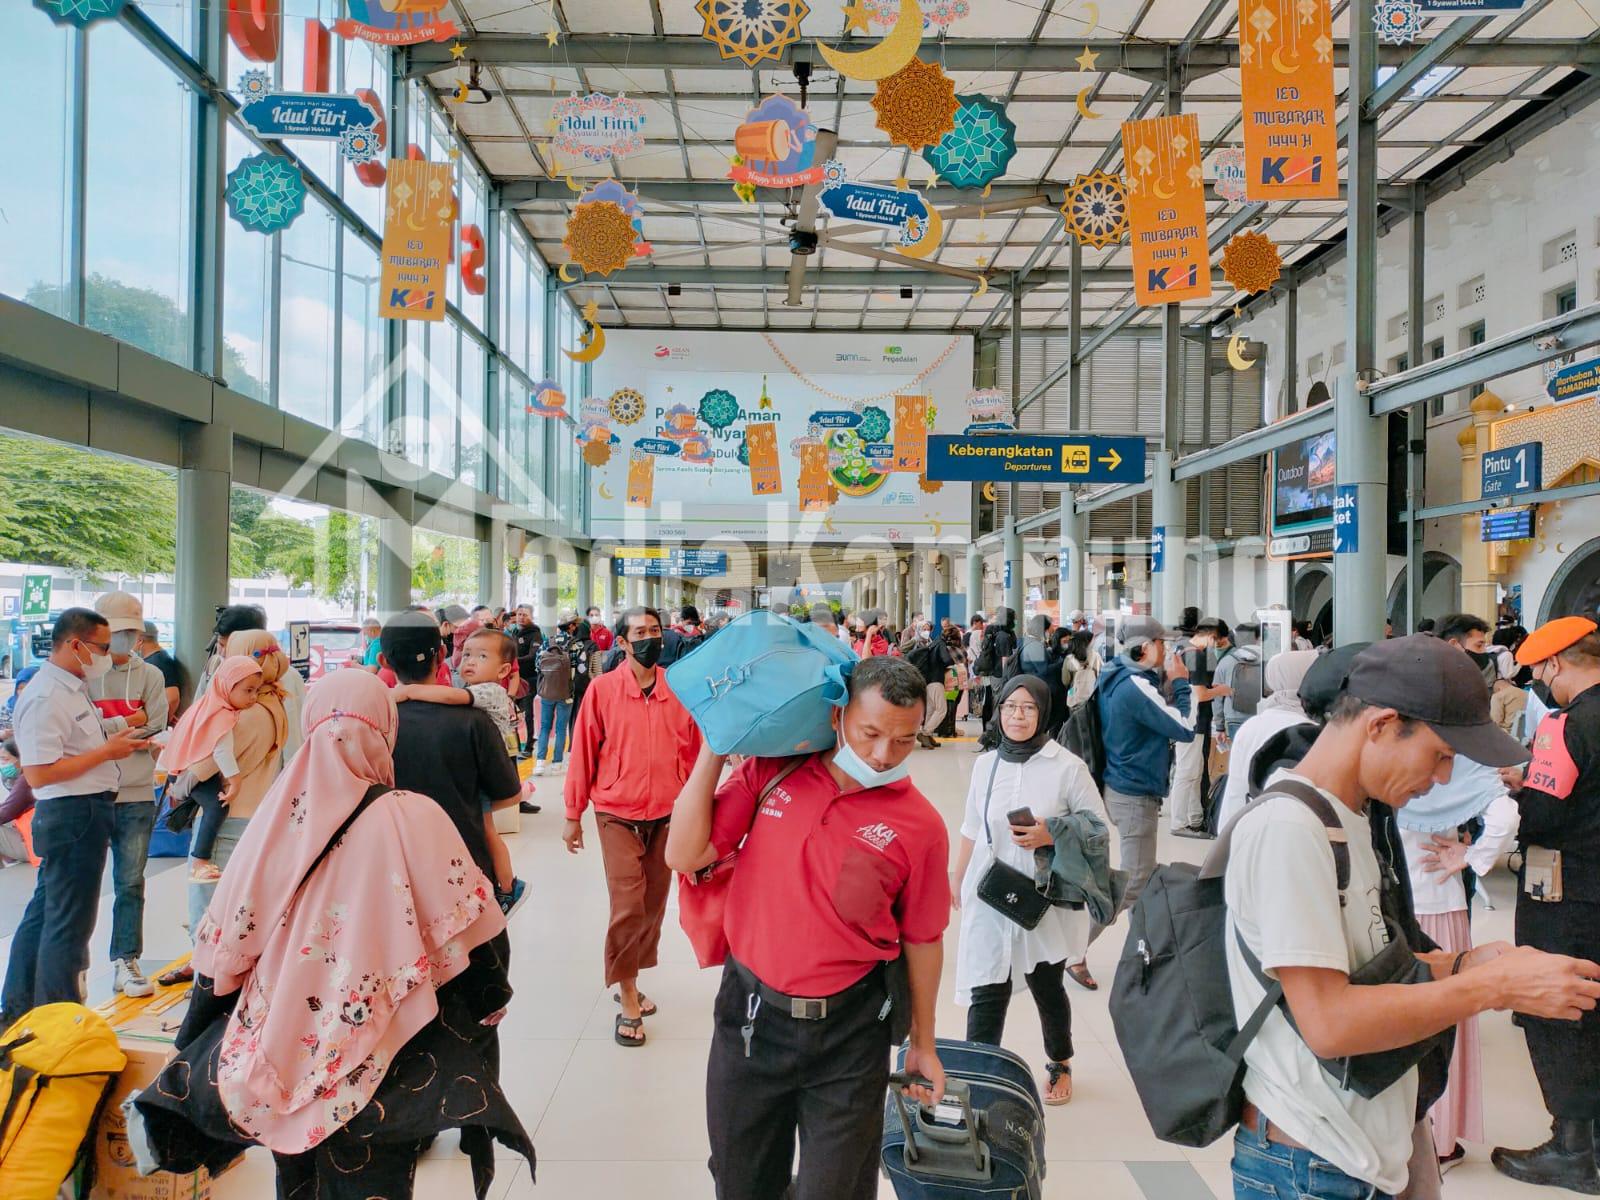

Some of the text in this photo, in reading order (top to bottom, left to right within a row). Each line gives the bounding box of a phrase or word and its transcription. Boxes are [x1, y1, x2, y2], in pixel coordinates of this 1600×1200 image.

[1276, 87, 1300, 100] IED
[272, 106, 347, 126] Idul Fitri
[564, 115, 634, 130] Idul Fitri
[1253, 109, 1327, 126] MUBARAK
[1268, 135, 1298, 147] 1444
[1224, 165, 1246, 179] Idu
[1261, 156, 1322, 185] KAI
[846, 194, 908, 217] Idul Fitri
[1158, 208, 1178, 221] IED
[1141, 226, 1199, 244] MUBARAK
[1148, 263, 1197, 291] KAI
[390, 288, 435, 310] KAI
[737, 408, 781, 421] Aman
[713, 427, 747, 442] Nya
[949, 443, 1054, 458] Keberangkatan
[1004, 461, 1053, 472] Departures
[1278, 465, 1305, 483] Outdoor
[1485, 456, 1511, 475] Pintu
[1514, 448, 1530, 489] 1
[1484, 479, 1502, 493] Gate
[1533, 772, 1556, 790] STA
